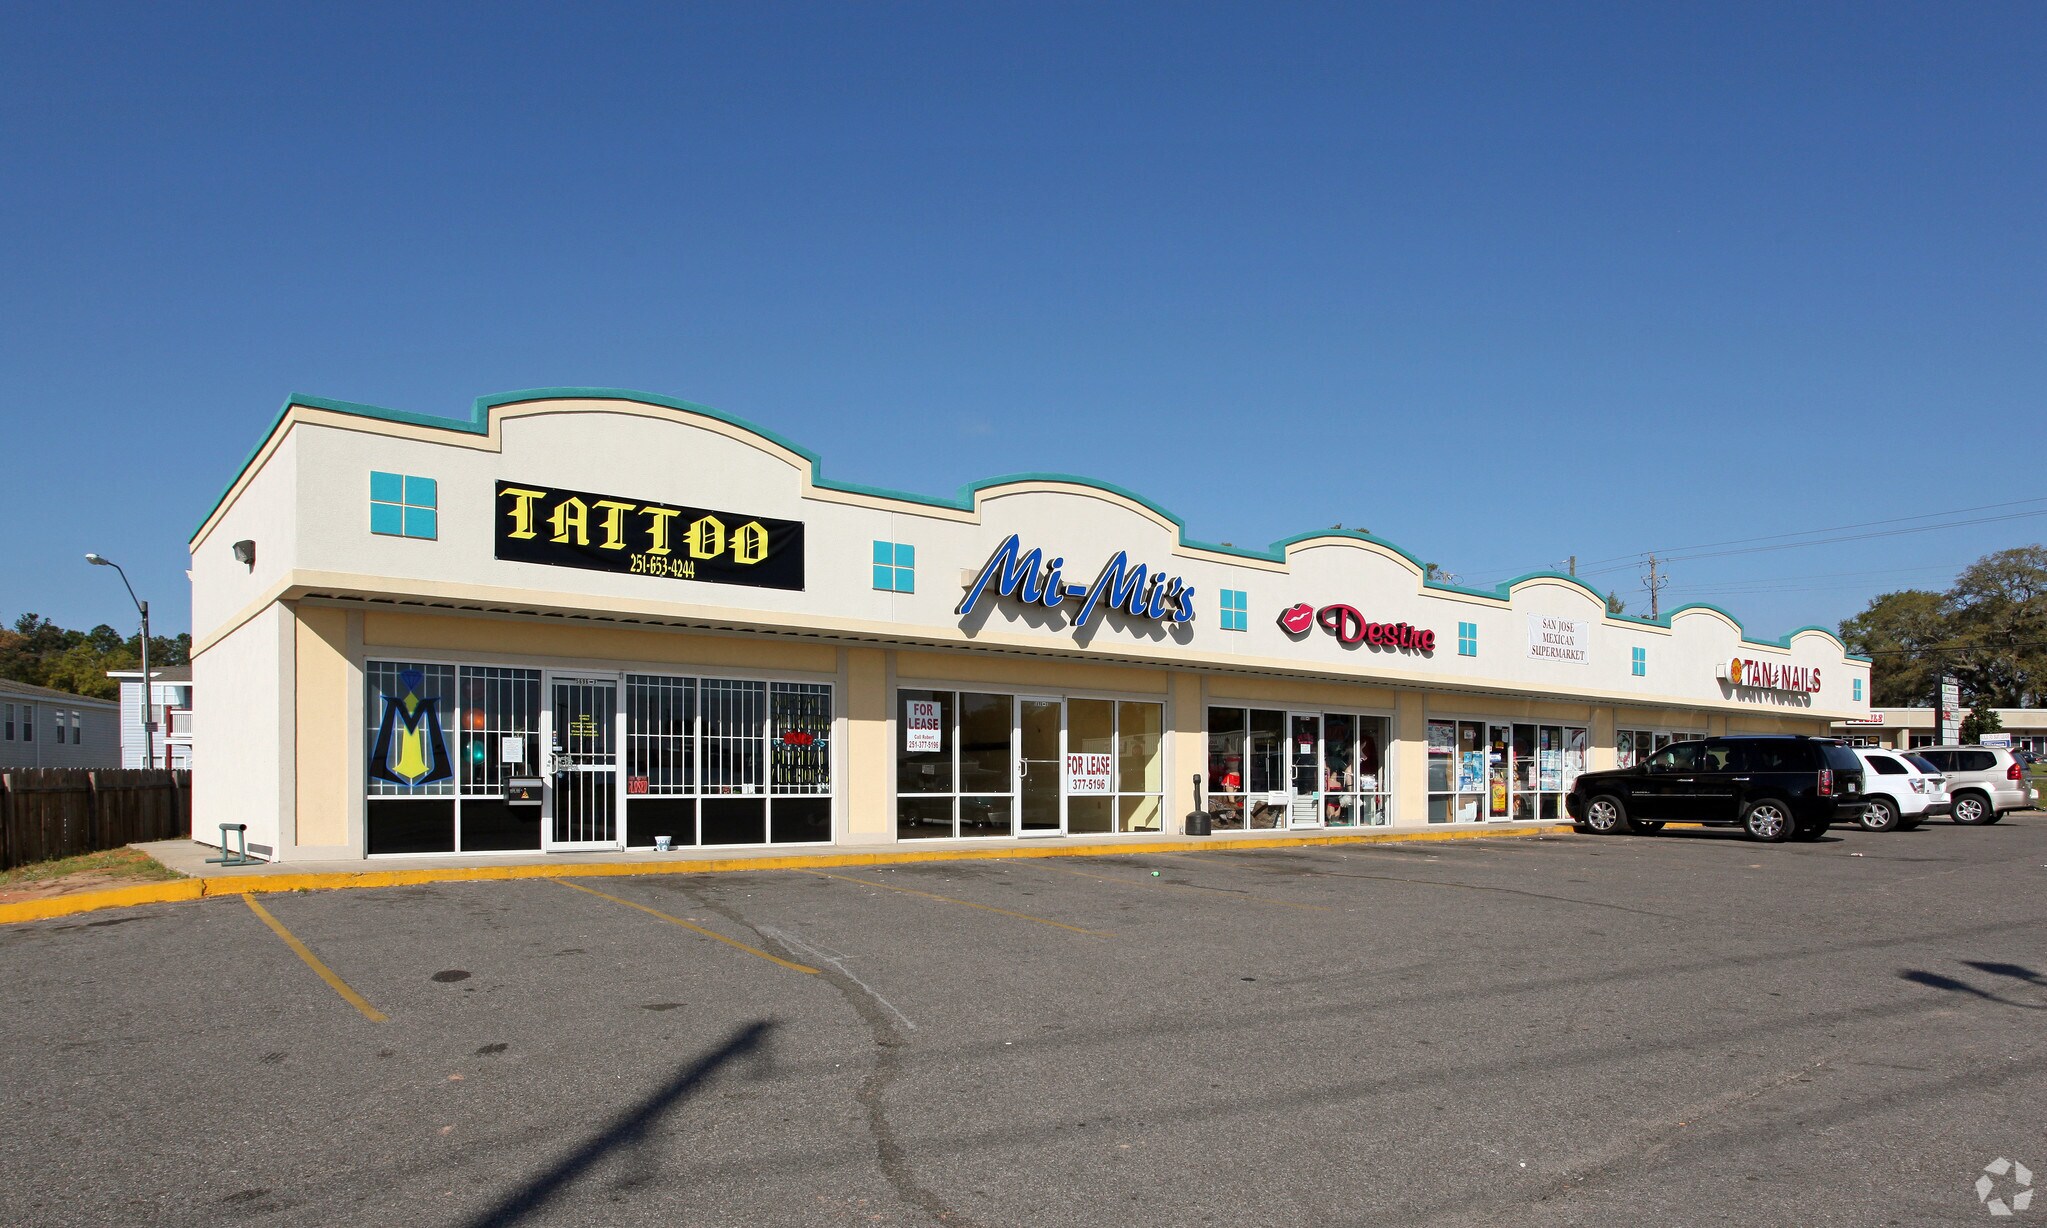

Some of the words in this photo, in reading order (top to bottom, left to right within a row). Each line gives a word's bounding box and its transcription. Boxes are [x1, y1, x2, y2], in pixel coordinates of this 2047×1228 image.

[499, 487, 769, 565] TATTOO
[630, 553, 695, 579] 251-653-4244
[957, 533, 1195, 627] Mi-Mi's
[1319, 603, 1435, 651] Desire
[1542, 618, 1557, 630] SAN
[1557, 620, 1575, 633] JOSE
[1542, 632, 1575, 646] MEXICAN
[1531, 645, 1585, 661] SUPERMARKET
[1744, 659, 1772, 687] TAN
[1781, 664, 1821, 693] NAILS
[914, 703, 933, 716] FOR
[908, 717, 939, 731] LEASE
[908, 740, 939, 749] 251-377-5196
[1067, 755, 1083, 776] FOR
[1086, 755, 1110, 776] LEASE
[1072, 778, 1106, 790] 377-5196
